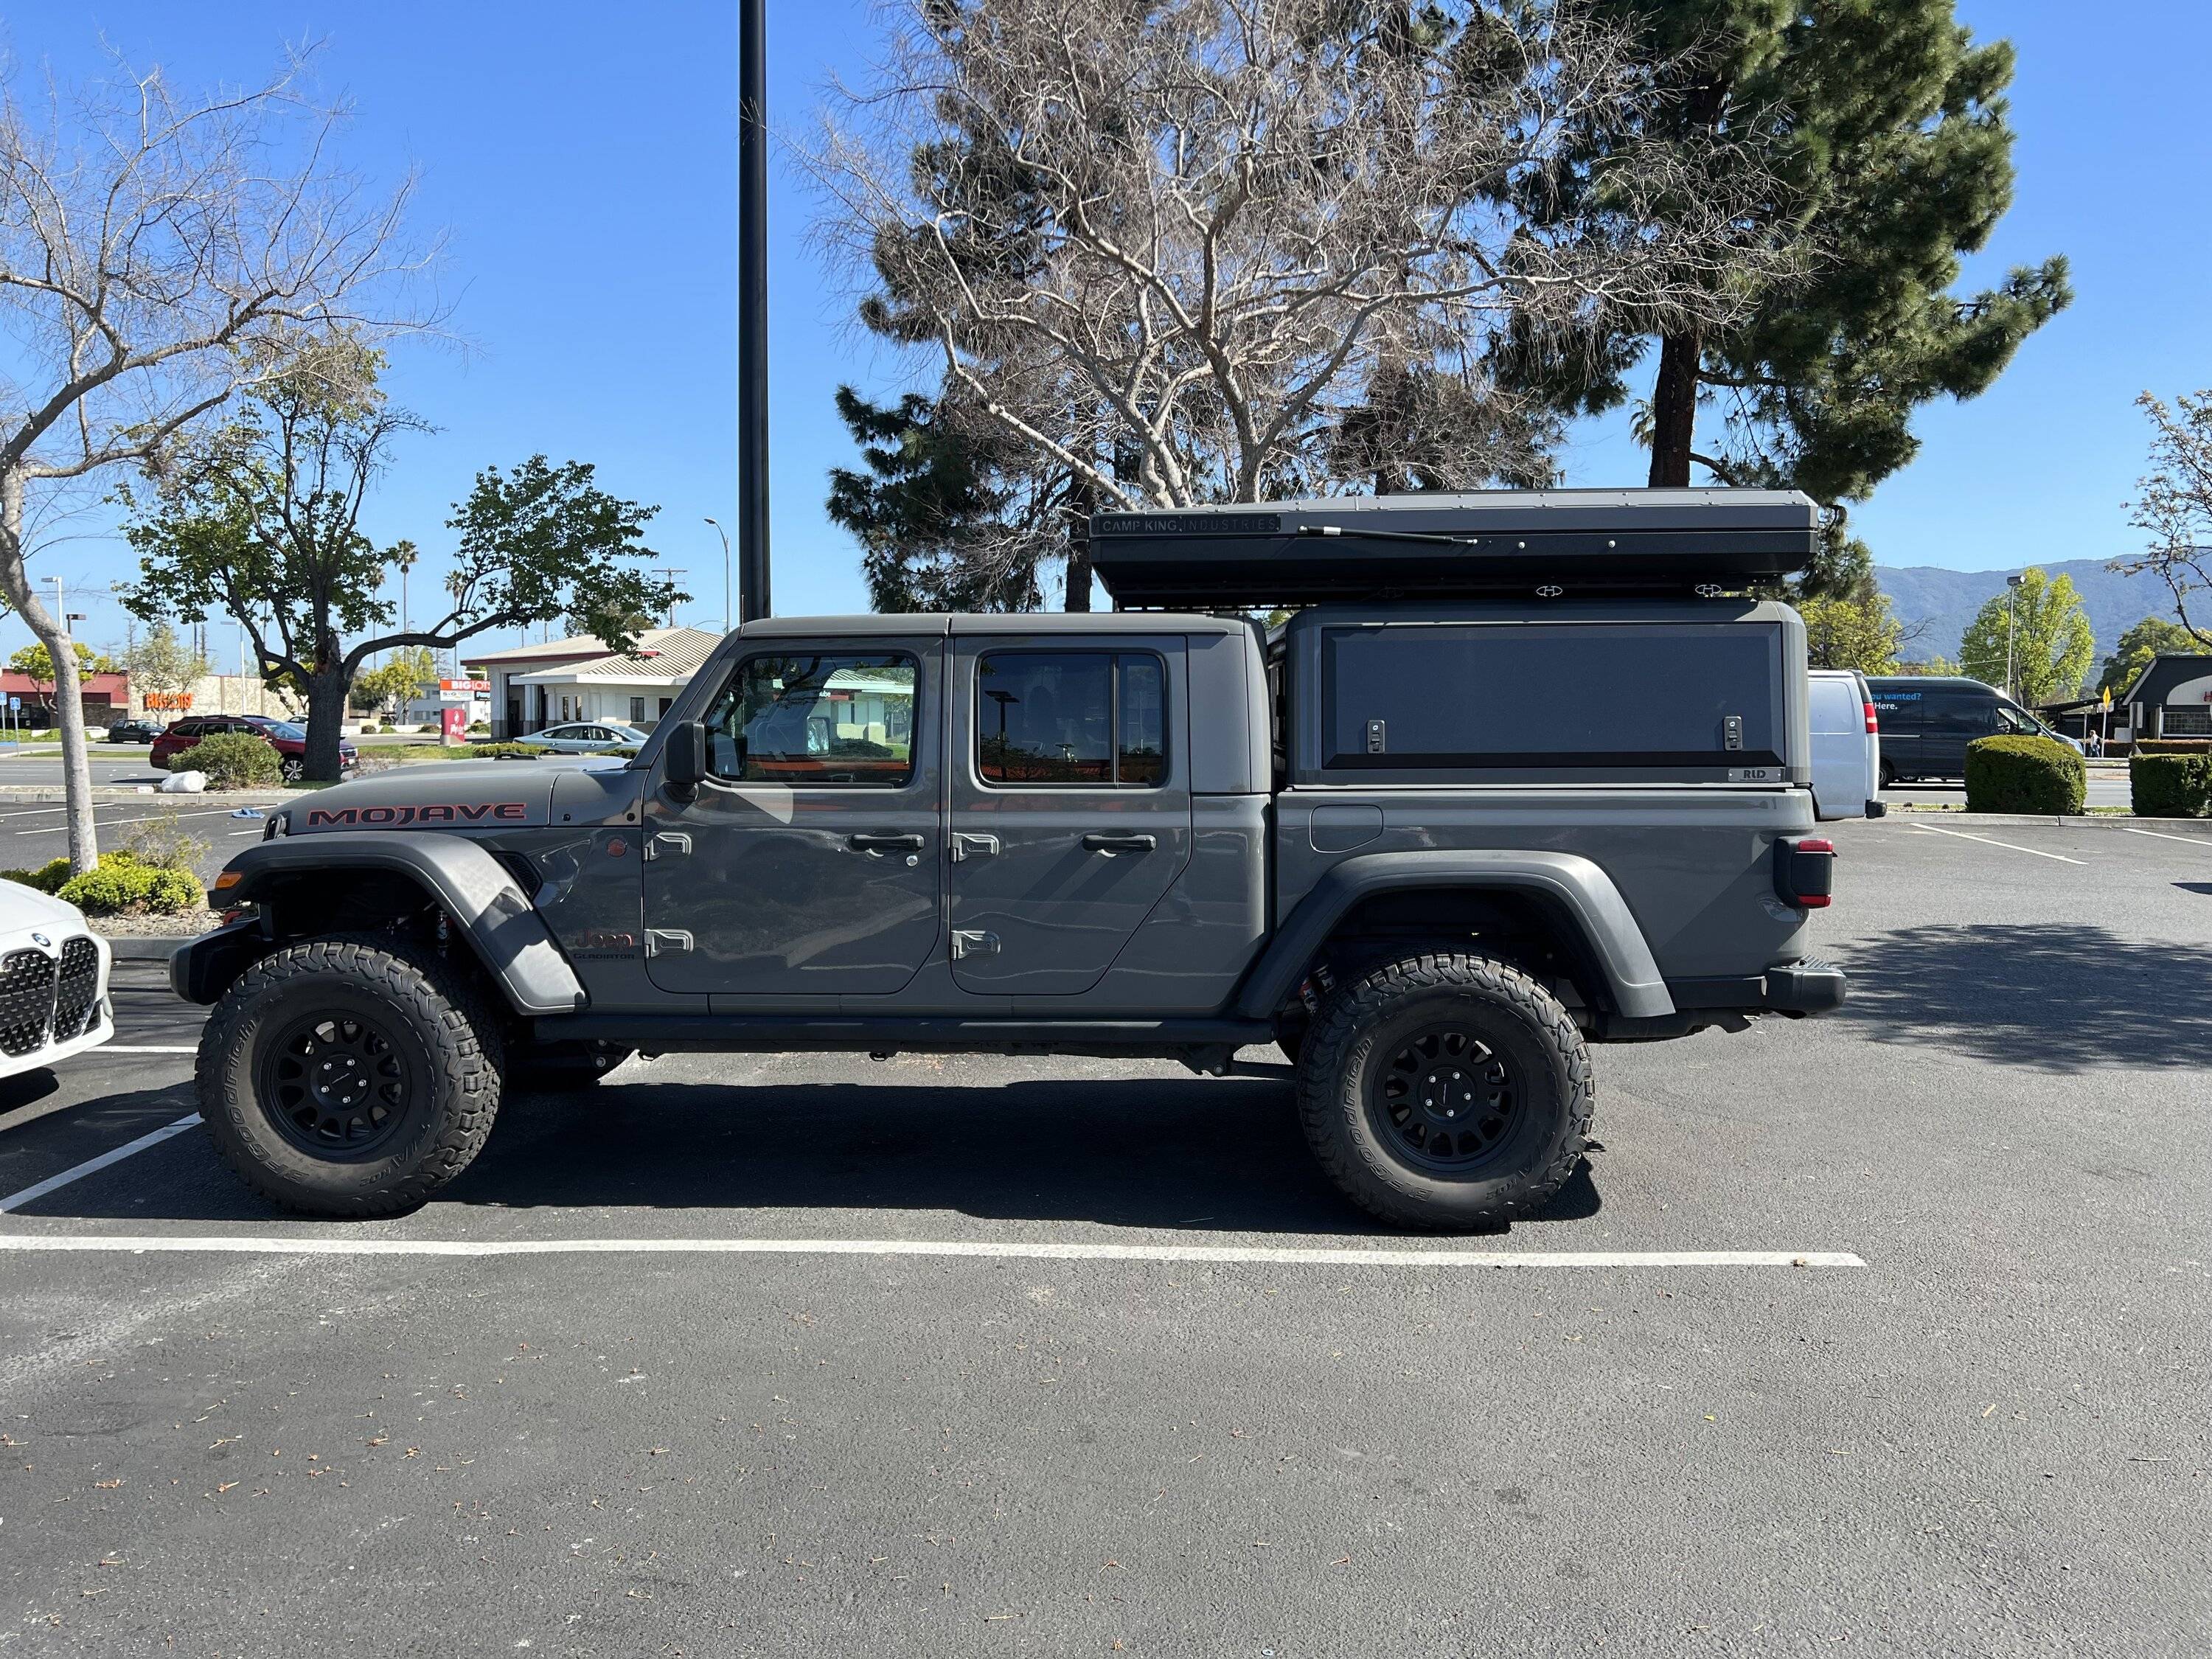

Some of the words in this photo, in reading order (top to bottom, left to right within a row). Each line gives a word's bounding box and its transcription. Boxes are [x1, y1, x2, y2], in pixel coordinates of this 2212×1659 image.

[1102, 520, 1141, 532] CAMP
[1144, 520, 1178, 532] KING
[1182, 518, 1276, 532] INDUSTRIES
[452, 681, 472, 689] BIG
[1743, 770, 1767, 779] RLD
[307, 803, 527, 827] MOJAVE
[577, 929, 635, 950] Jeep
[223, 1018, 310, 1186] BFGoodrich
[1341, 1038, 1434, 1202] BFGoodrich
